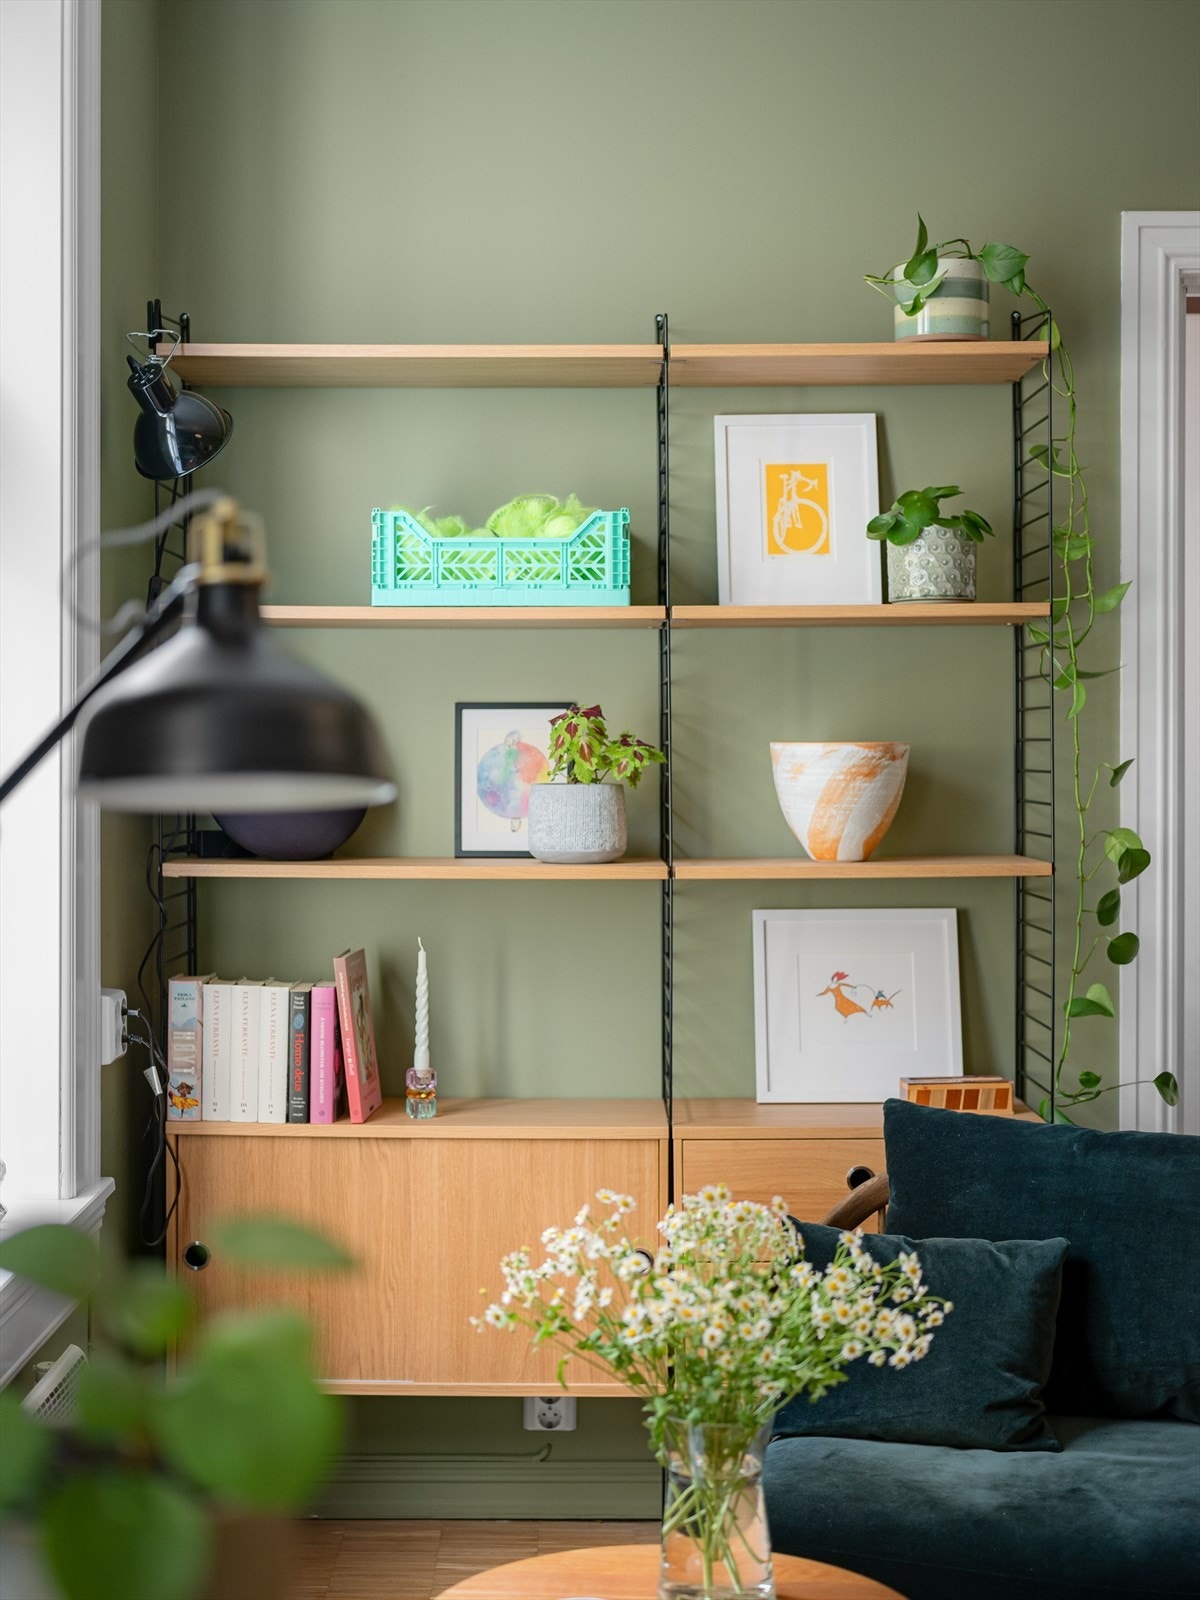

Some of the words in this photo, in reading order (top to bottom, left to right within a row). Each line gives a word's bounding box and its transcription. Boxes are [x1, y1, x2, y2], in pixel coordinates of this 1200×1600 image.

[172, 1031, 197, 1075] HØYT
[294, 1033, 304, 1066] Homo
[294, 1068, 304, 1092] deus
